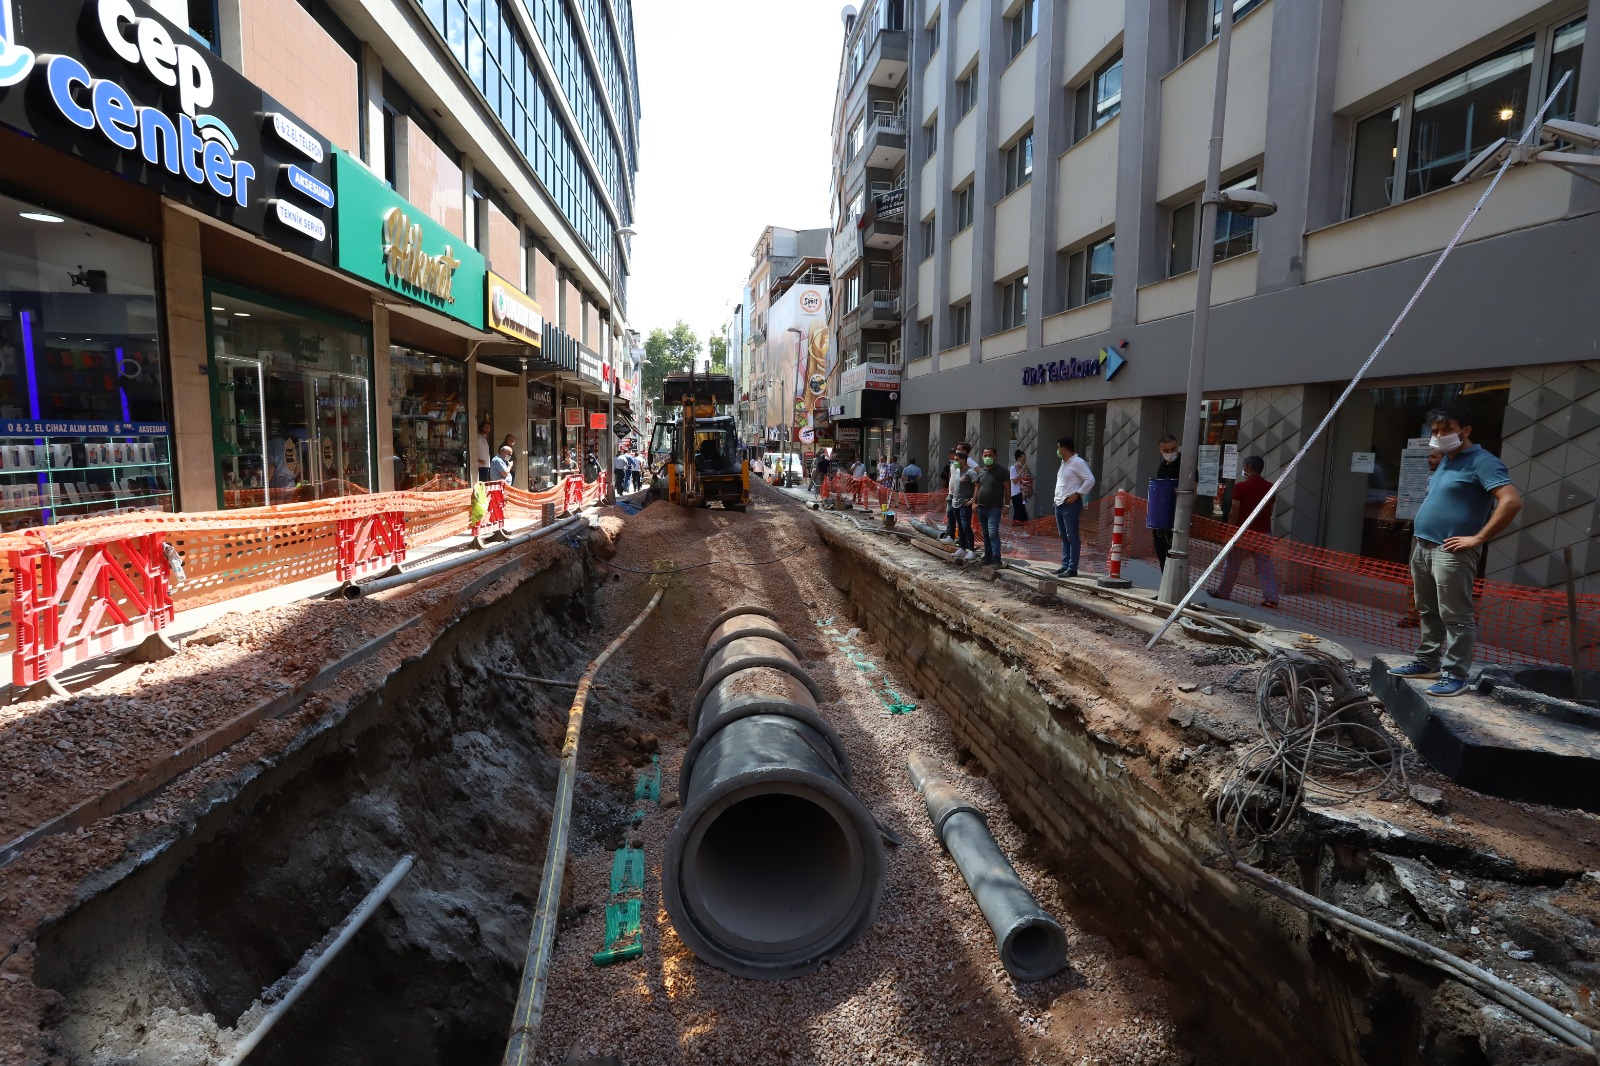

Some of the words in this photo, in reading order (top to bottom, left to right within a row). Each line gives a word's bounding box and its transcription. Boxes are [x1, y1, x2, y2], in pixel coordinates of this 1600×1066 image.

[97, 0, 214, 117] cep
[47, 54, 256, 208] center
[298, 133, 322, 159] TELEFON
[294, 171, 330, 203] AKSESUAR
[280, 206, 303, 226] TEKNİK
[303, 218, 323, 237] SERVİS
[1022, 364, 1046, 386] Türk
[1046, 357, 1100, 382] Telekom
[16, 423, 23, 432] &
[35, 423, 44, 433] EL
[69, 424, 87, 433] ALIM
[88, 424, 109, 433] SATIM
[138, 425, 167, 433] AKSESUAR
